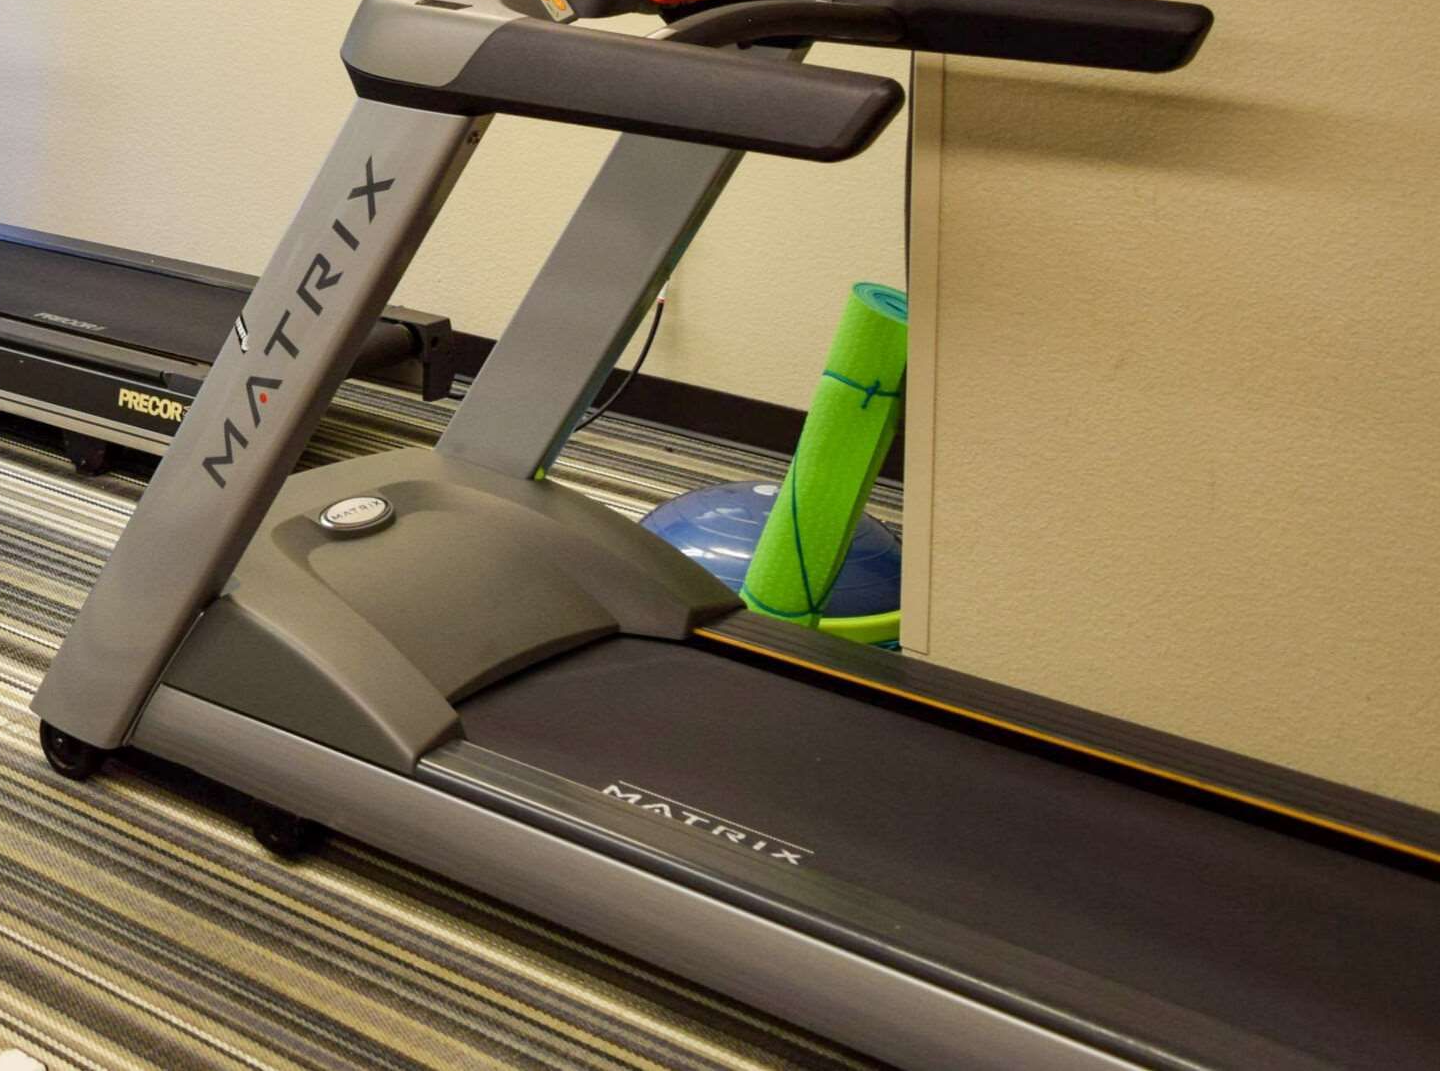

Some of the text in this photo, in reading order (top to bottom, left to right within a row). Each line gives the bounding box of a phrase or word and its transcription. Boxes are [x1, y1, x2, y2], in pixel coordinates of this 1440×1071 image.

[202, 155, 396, 489] MATRIX
[118, 388, 182, 423] PRECOR
[330, 499, 383, 521] MATRIX
[601, 783, 803, 866] MATRIX
